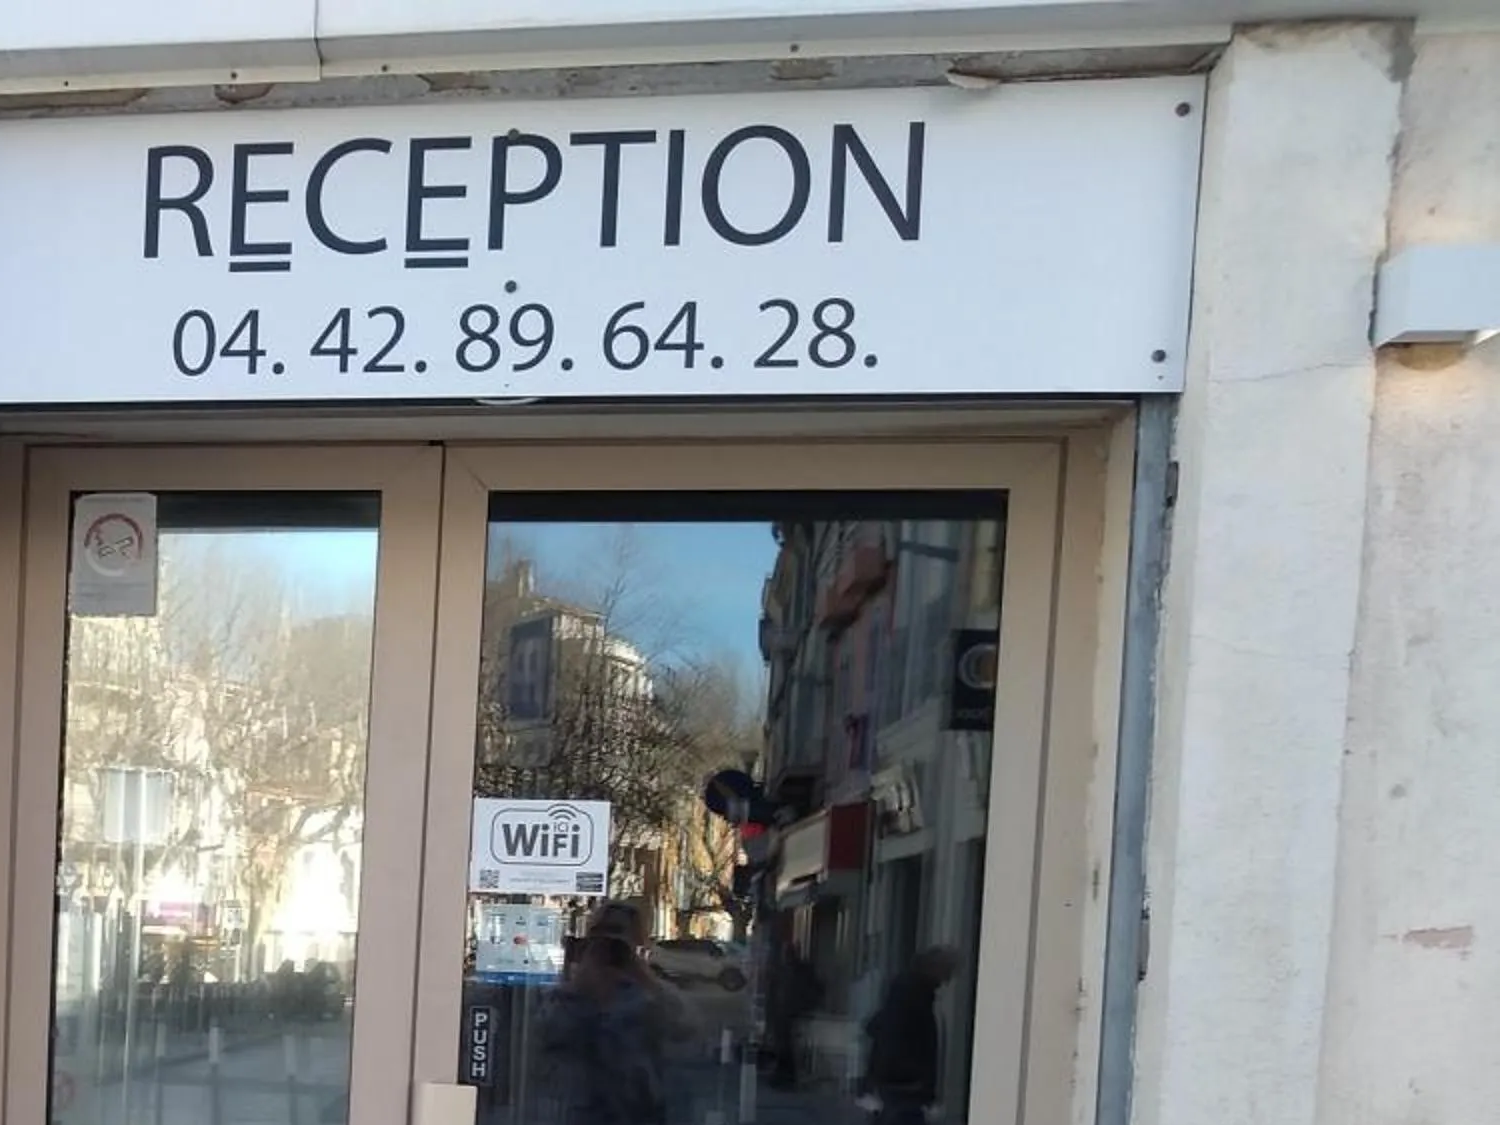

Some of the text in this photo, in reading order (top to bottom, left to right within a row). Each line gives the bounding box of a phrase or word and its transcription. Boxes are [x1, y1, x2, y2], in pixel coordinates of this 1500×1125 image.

[142, 121, 927, 273] RECEPTION
[173, 297, 878, 377] 04. 42. 89. 64. 28.
[502, 823, 580, 858] WiFi
[472, 1012, 488, 1077] PUSH
